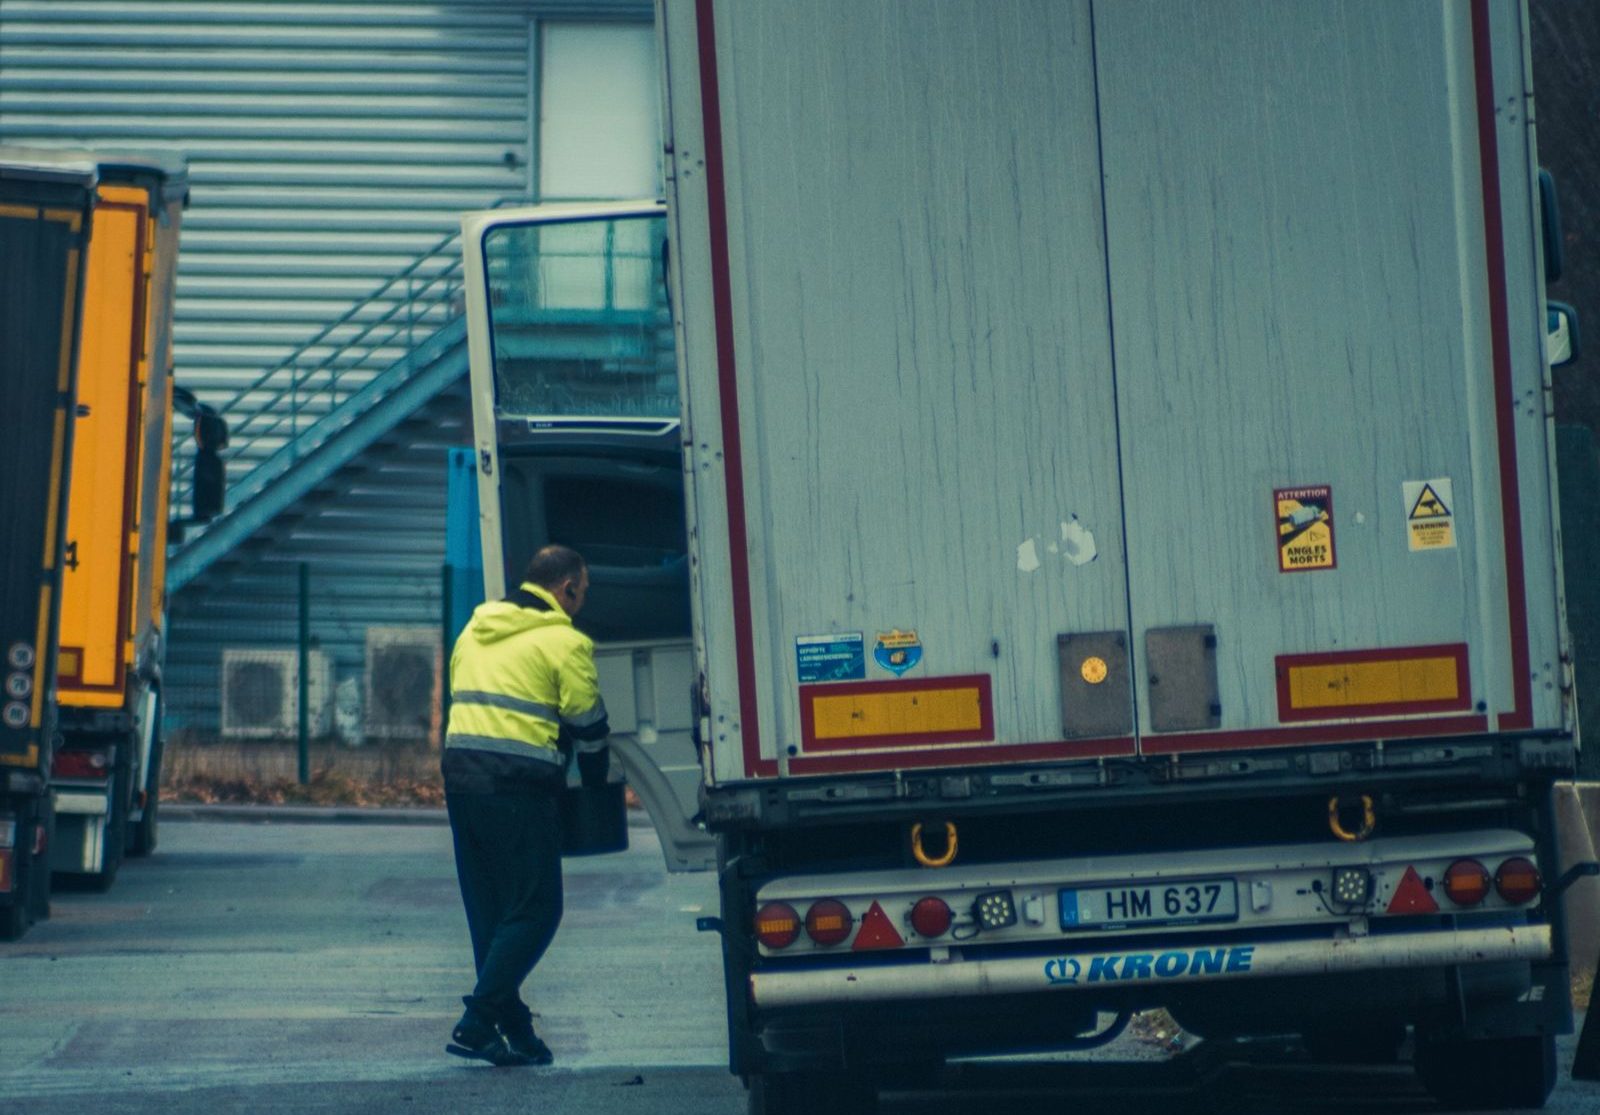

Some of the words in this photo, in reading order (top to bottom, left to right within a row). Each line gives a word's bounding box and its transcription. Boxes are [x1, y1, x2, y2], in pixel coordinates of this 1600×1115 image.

[1278, 488, 1328, 499] ATTENTION
[1412, 521, 1450, 531] WARNING
[1287, 545, 1327, 556] ANGLES
[1289, 555, 1326, 565] MORTS
[1063, 911, 1076, 921] LT
[1106, 889, 1152, 919] HM
[1164, 885, 1221, 915] 637
[1088, 947, 1255, 983] KRONE
